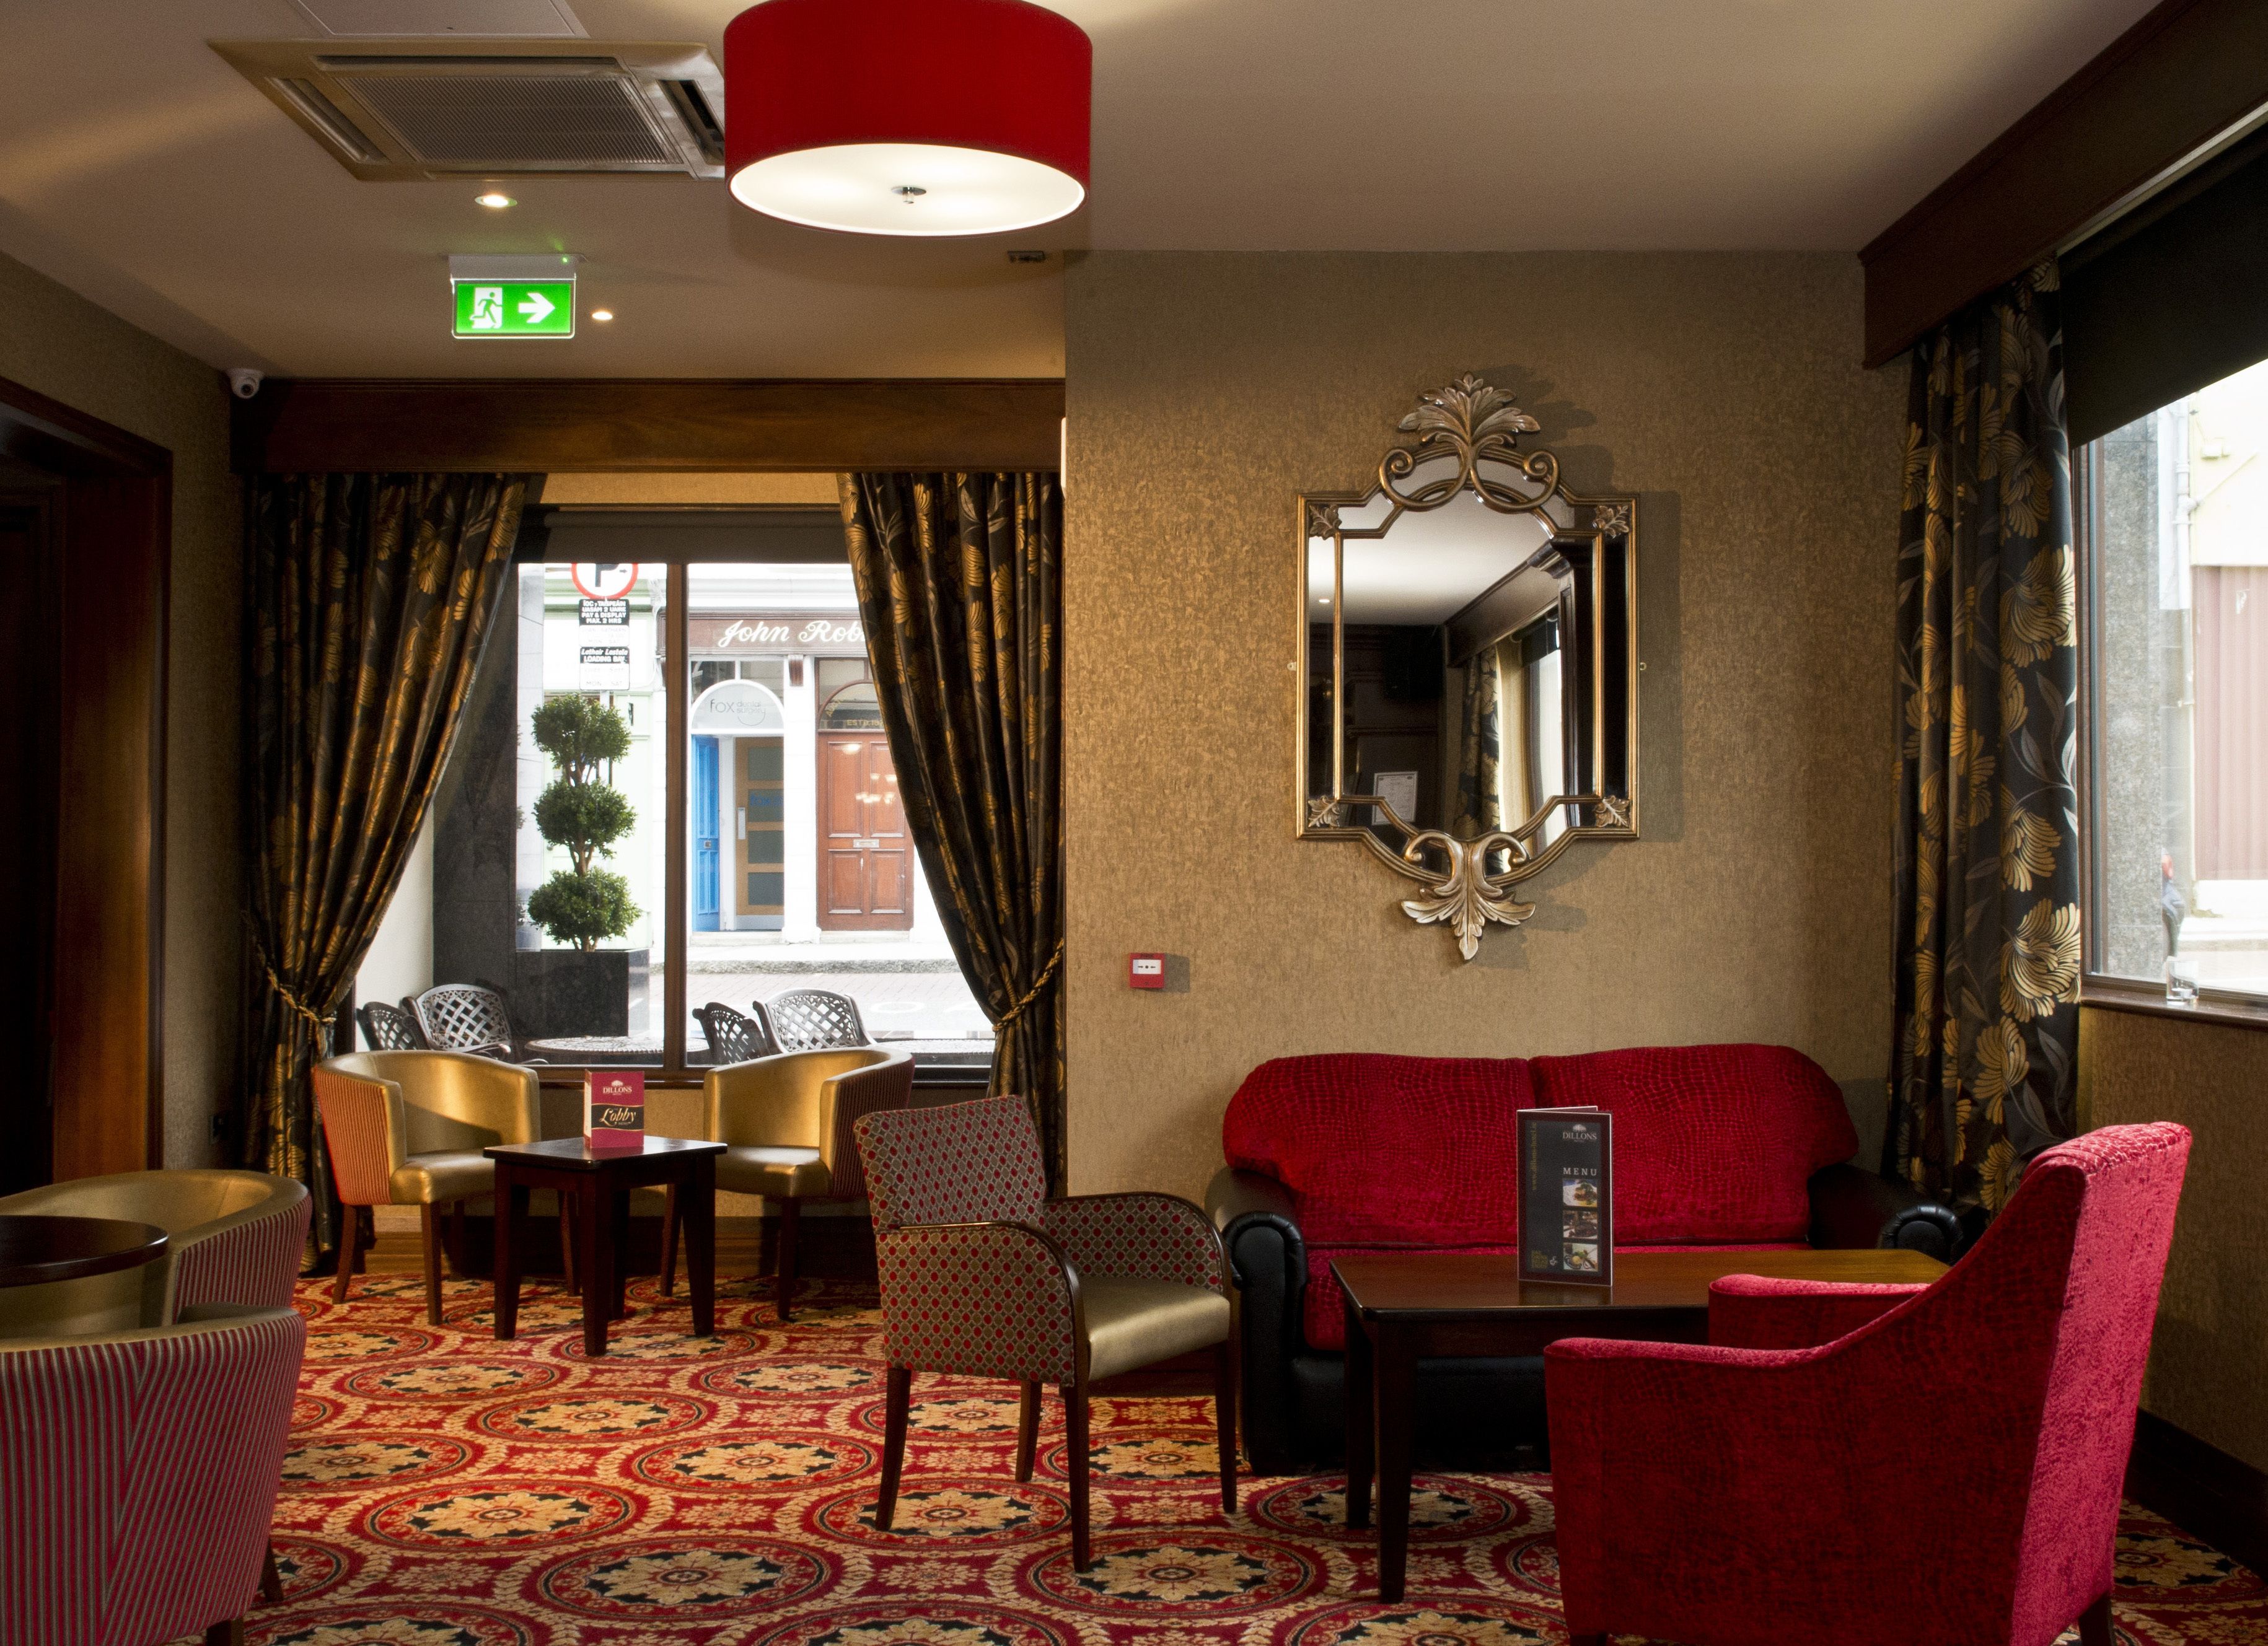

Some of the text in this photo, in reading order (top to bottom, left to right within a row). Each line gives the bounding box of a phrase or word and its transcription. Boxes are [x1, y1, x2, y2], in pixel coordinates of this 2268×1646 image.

[718, 619, 790, 647] John
[710, 699, 734, 713] fox
[603, 1086, 633, 1094] DILLONS
[599, 1108, 636, 1126] Lobby
[1562, 1132, 1598, 1140] DILLONS
[1562, 1167, 1598, 1176] MENU
